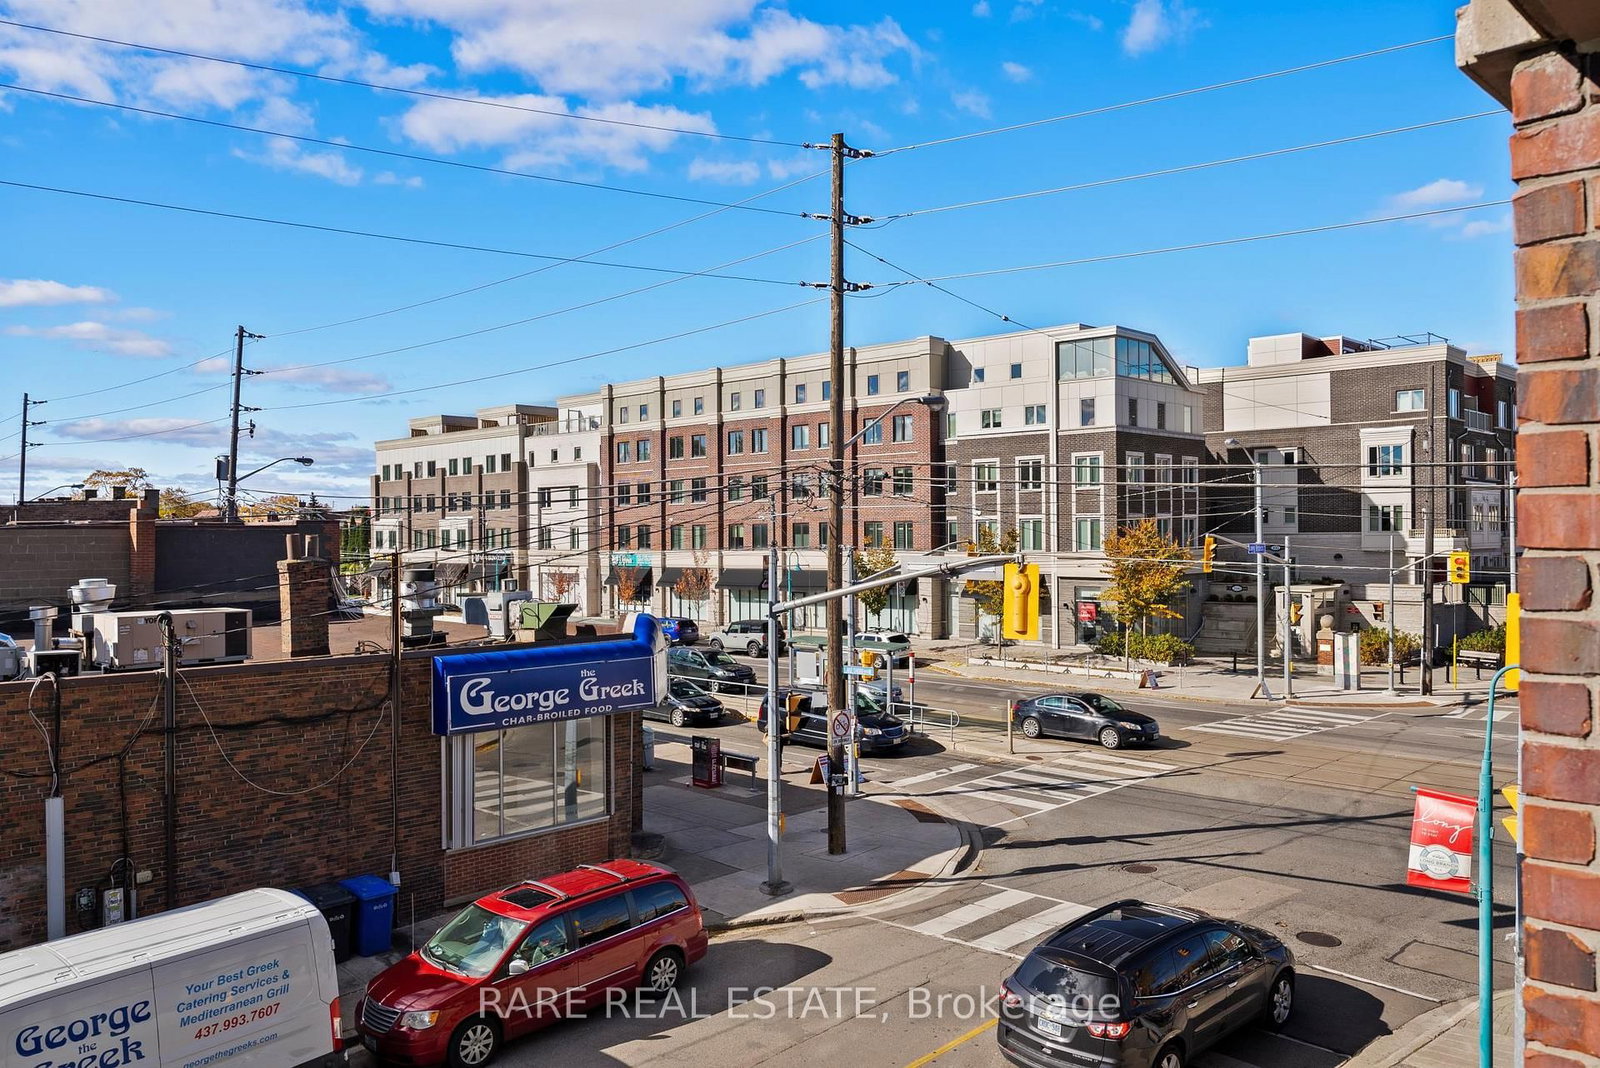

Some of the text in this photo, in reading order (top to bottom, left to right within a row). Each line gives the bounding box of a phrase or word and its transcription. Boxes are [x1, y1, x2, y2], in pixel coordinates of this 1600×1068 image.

[581, 669, 596, 678] the
[459, 677, 645, 716] George Greek
[502, 704, 613, 726] CHAR-BROILED FOOD
[176, 969, 290, 1014] Catering Services &
[185, 958, 280, 995] Your Best Greek
[179, 984, 290, 1028] Mediterranean Grill
[194, 1002, 281, 1041] 437.993.7607
[15, 1000, 152, 1058] George
[78, 1041, 97, 1056] the
[183, 1032, 278, 1068] georgethegreeks.com
